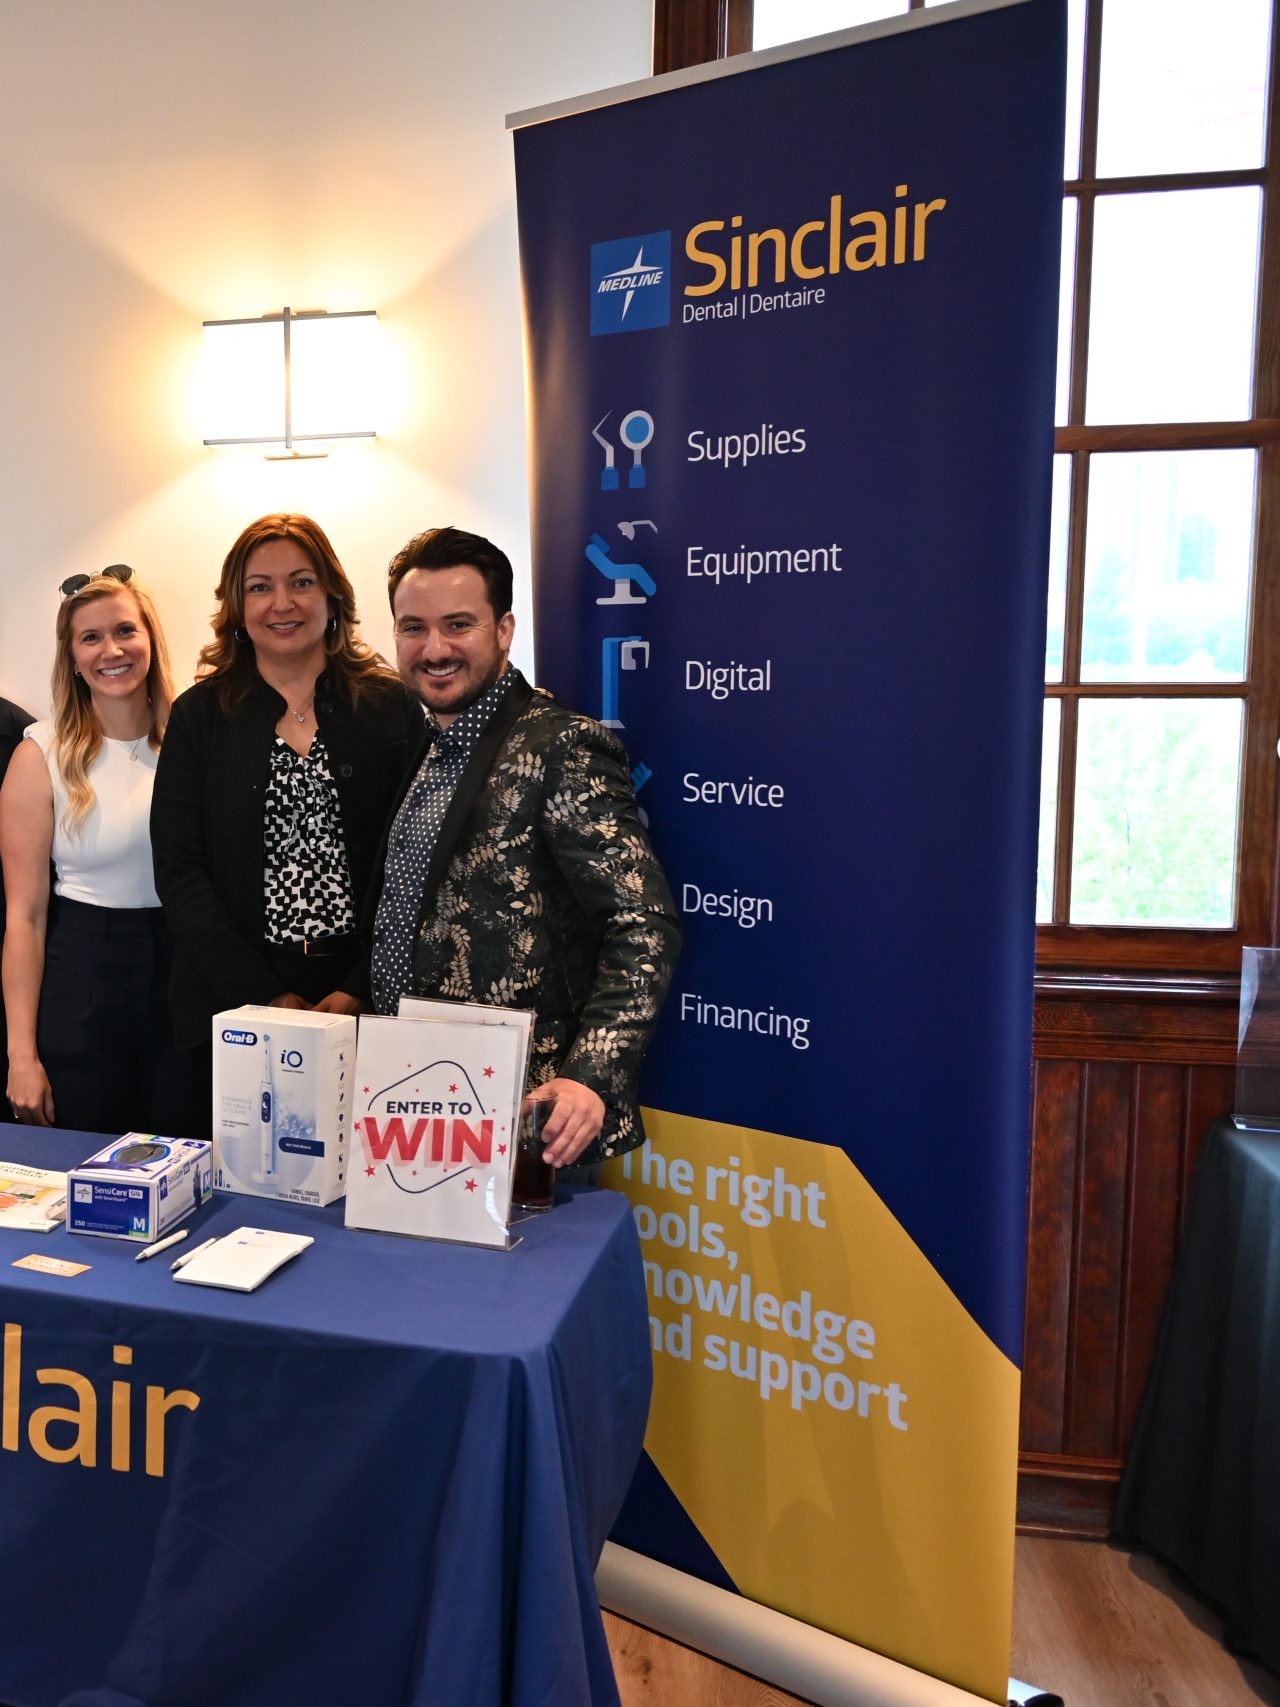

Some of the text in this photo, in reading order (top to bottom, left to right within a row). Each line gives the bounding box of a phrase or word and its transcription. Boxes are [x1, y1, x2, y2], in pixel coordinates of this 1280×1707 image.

[684, 184, 947, 297] Sinclair
[597, 271, 664, 293] MEDLINE
[687, 424, 807, 468] Supplies
[687, 543, 842, 585] Equipment
[686, 659, 771, 700] Digital
[683, 772, 784, 807] Service
[682, 884, 773, 928] Design
[223, 1031, 255, 1044] Oral-B
[681, 993, 810, 1049] Financing
[386, 1101, 472, 1115] ENTER TO
[363, 1117, 494, 1164] WIN
[94, 1186, 142, 1198] SensiCare Silk
[706, 1156, 827, 1229] right
[133, 1217, 146, 1231] M
[633, 1204, 739, 1270] ools,
[643, 1260, 876, 1365] nowledge
[648, 1313, 909, 1432] nd support
